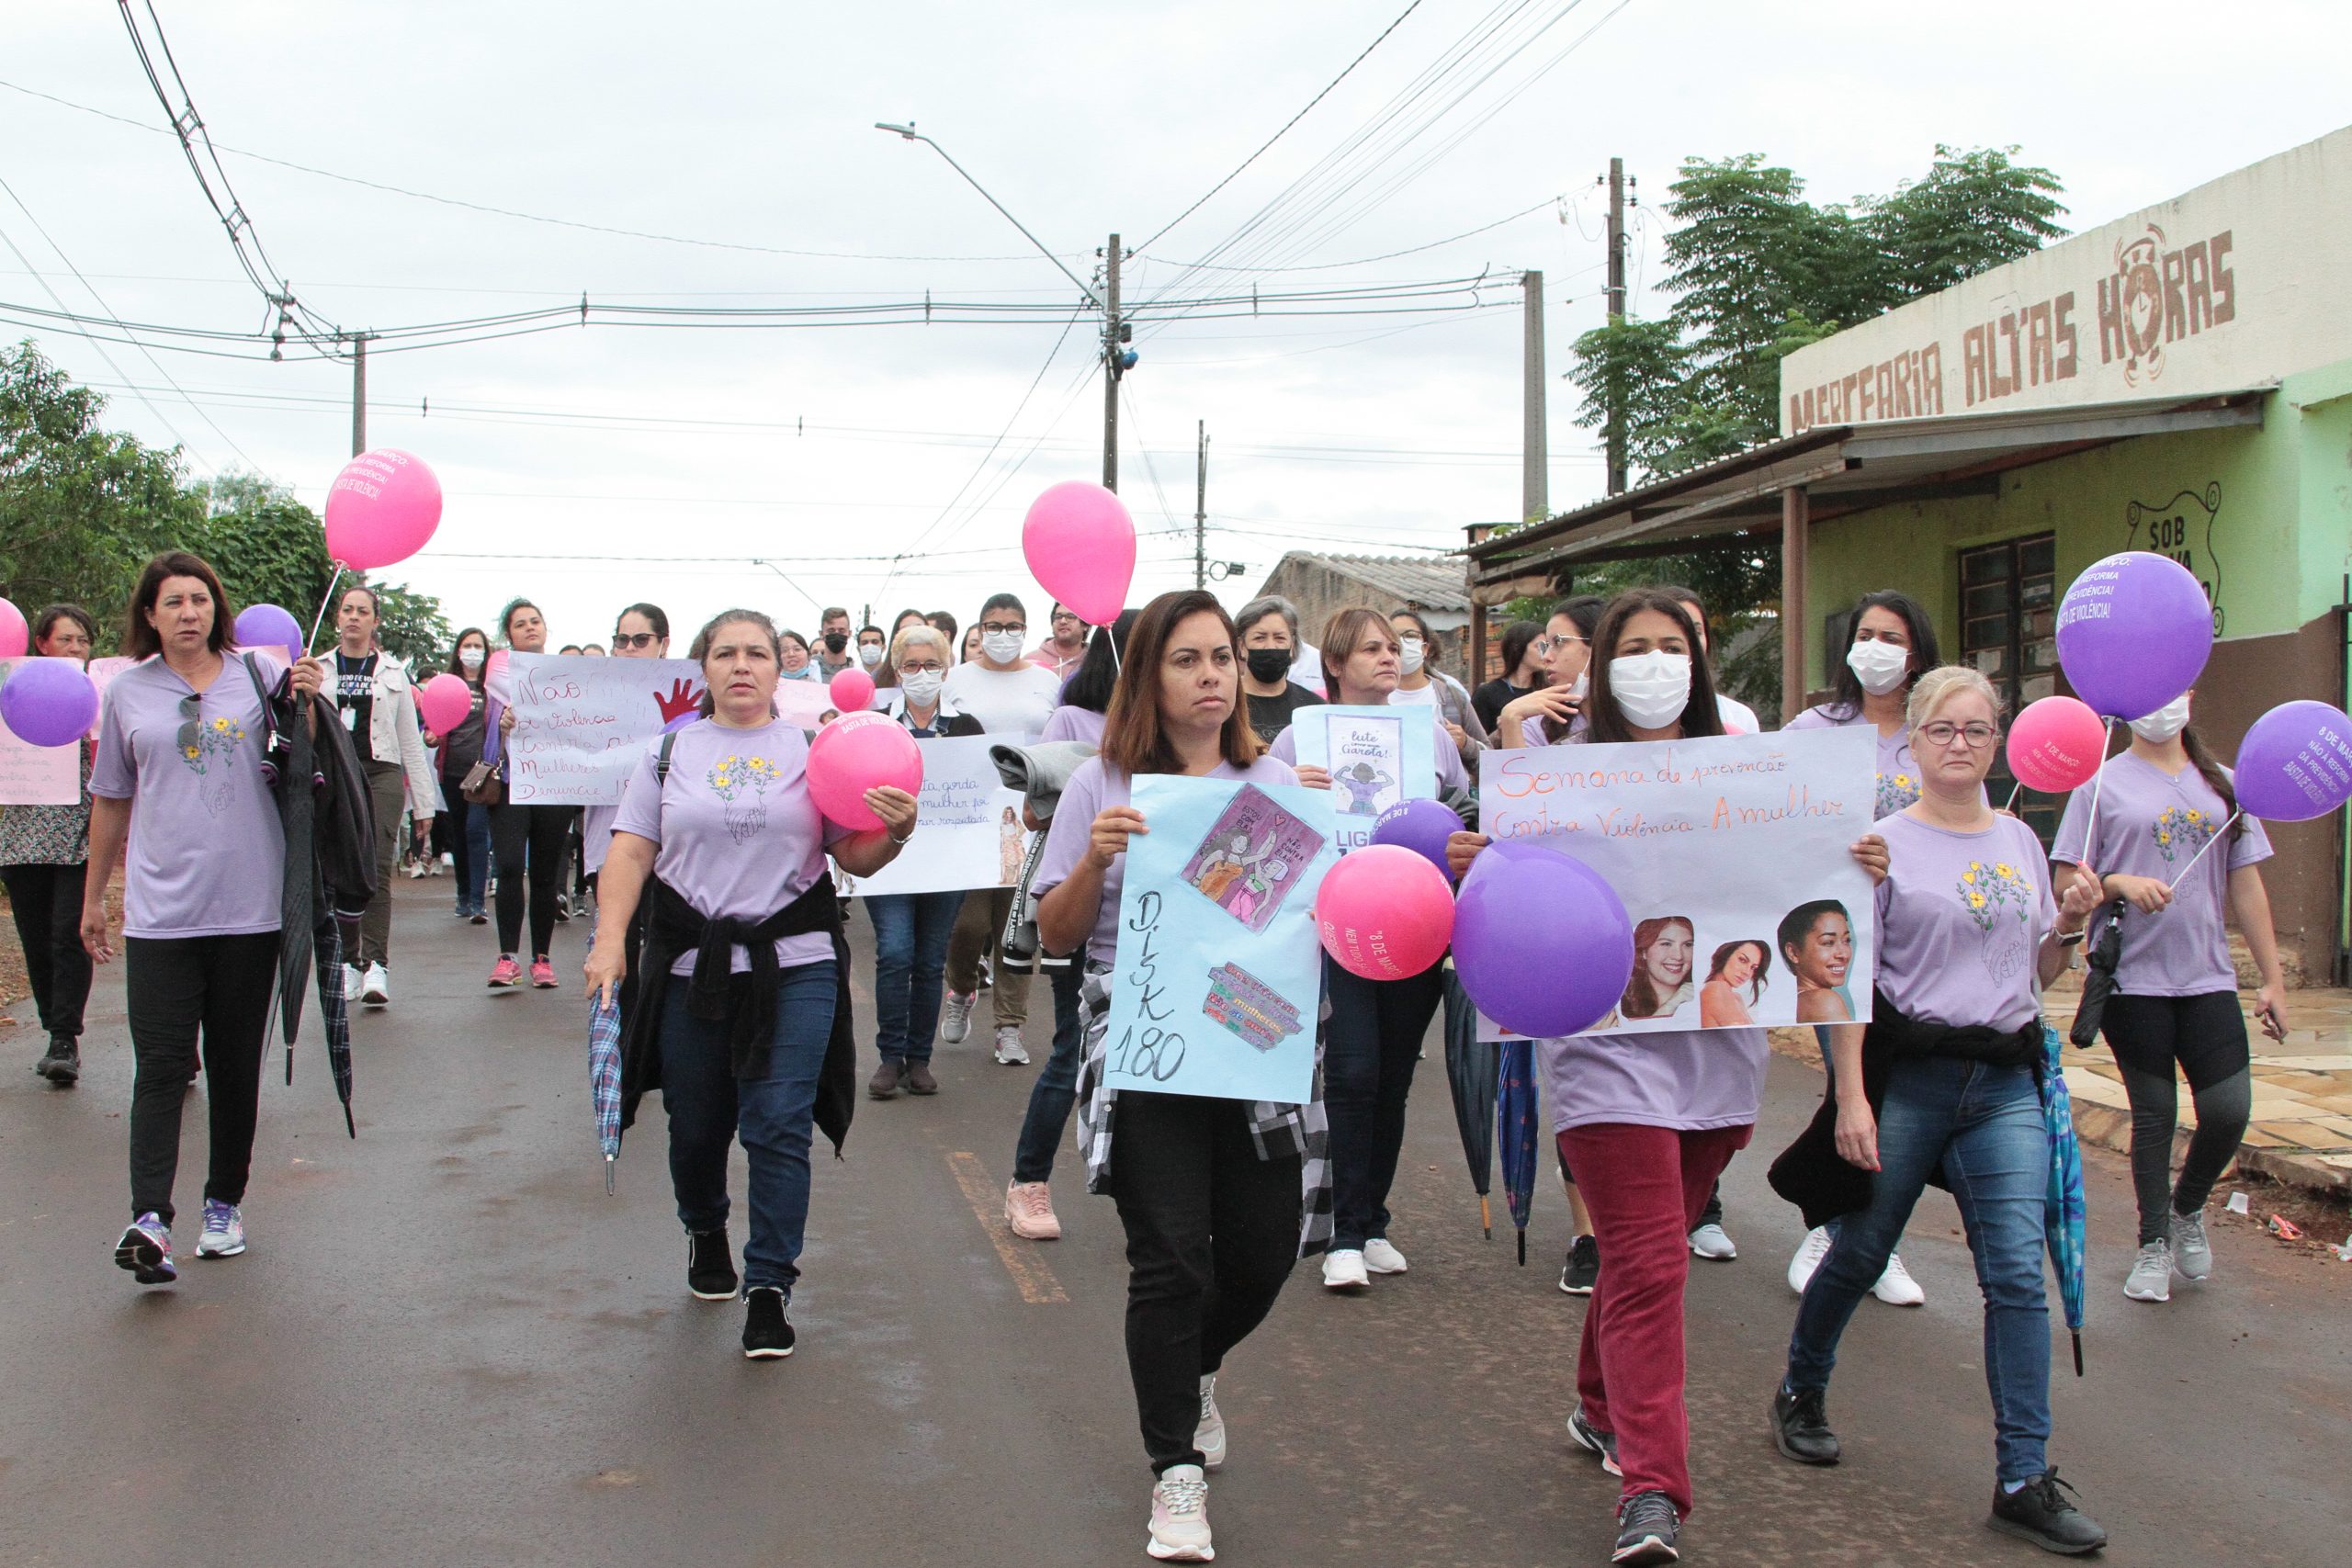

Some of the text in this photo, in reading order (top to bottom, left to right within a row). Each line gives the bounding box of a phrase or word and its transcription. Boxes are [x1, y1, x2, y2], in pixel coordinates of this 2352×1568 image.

[1963, 291, 2077, 408] ALTAS
[2149, 514, 2186, 551] SOB
[518, 667, 581, 706] Não
[2318, 726, 2327, 736] 8
[2324, 730, 2339, 747] DE
[1497, 756, 1651, 797] Semana
[1657, 747, 1682, 784] de
[2298, 751, 2310, 764] DA
[2308, 740, 2324, 756] NÃO
[2326, 757, 2351, 784] REFORMA
[1493, 801, 1585, 838] Contra
[1713, 796, 1732, 831] A
[1734, 784, 1845, 824] mulher
[1336, 830, 1369, 848] LIG
[1344, 927, 1359, 944] NEM
[1371, 942, 1388, 956] DE
[1109, 1025, 1185, 1081] 180
